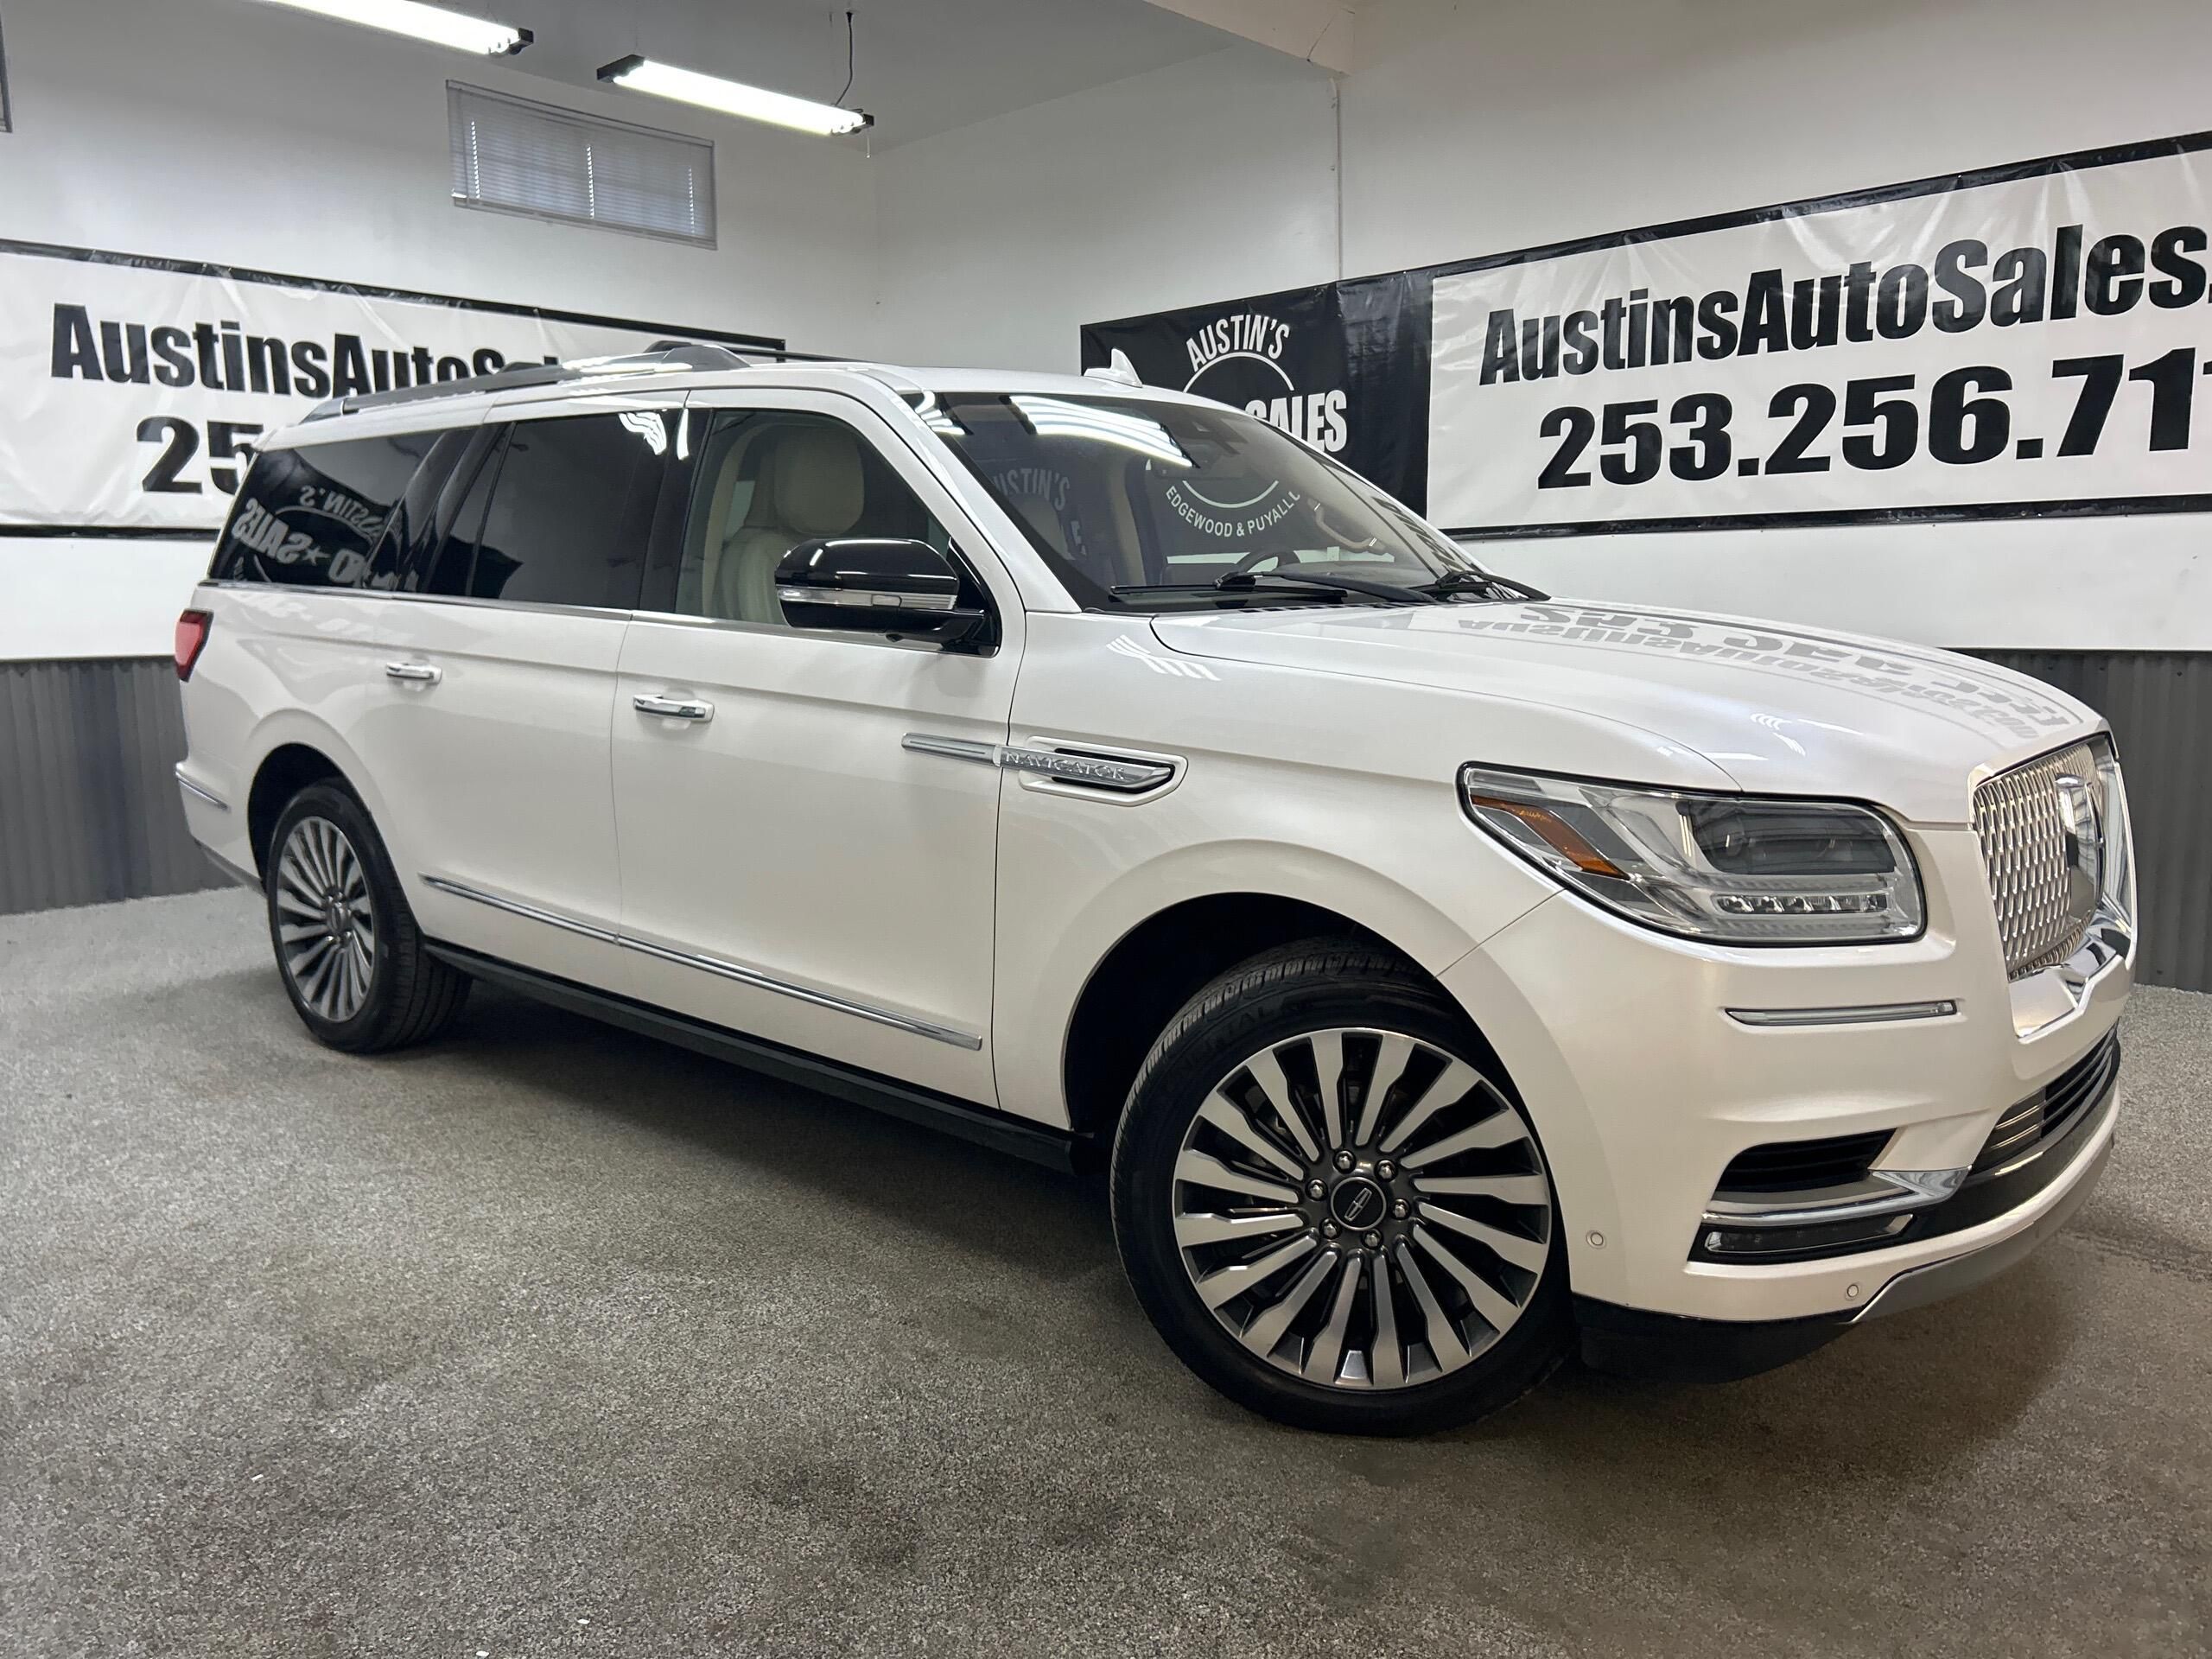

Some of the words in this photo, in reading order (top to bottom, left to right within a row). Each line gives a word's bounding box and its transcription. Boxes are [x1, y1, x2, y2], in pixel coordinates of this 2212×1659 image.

[1478, 223, 2212, 385] AustinsAutoSales
[1185, 314, 1290, 372] AUSTIN'S
[1536, 346, 2212, 490] 253.256.71
[1166, 485, 1233, 537] EDGEWOOD
[1236, 522, 1245, 537] &
[1247, 491, 1300, 535] PUYALLU
[1004, 752, 1126, 781] NAVIGATOR
